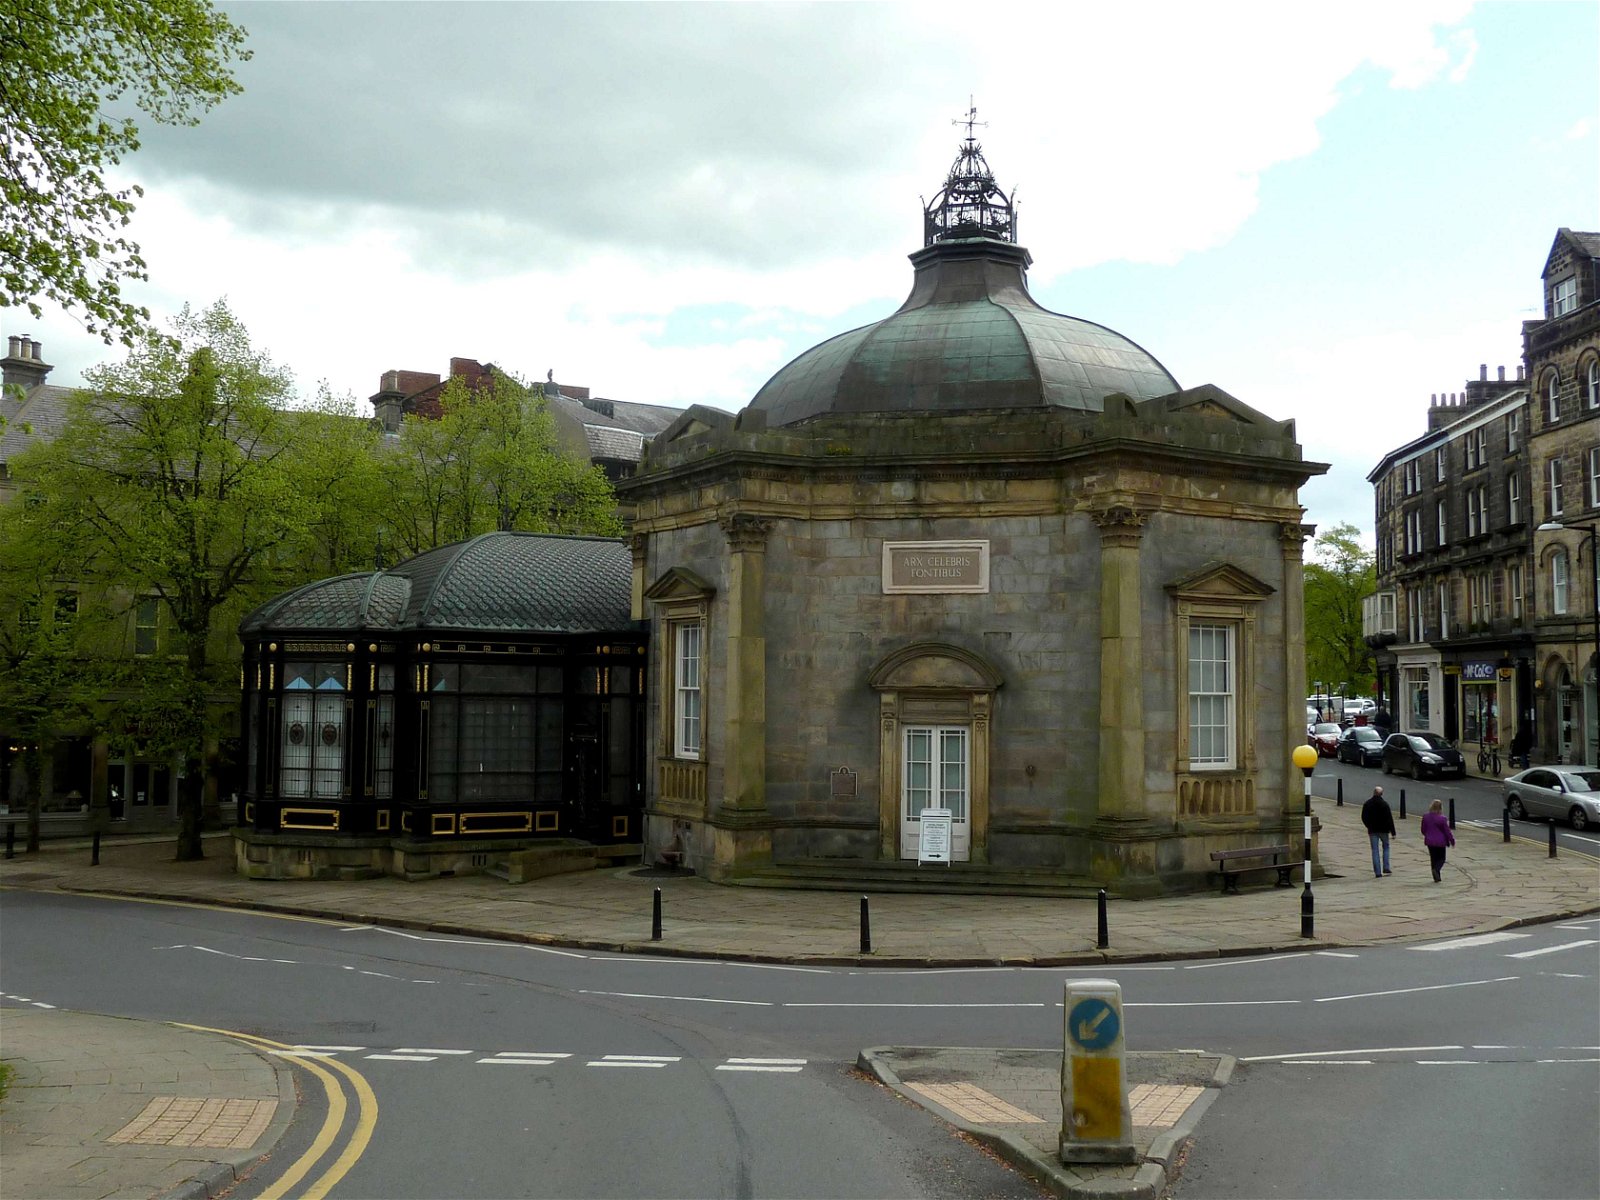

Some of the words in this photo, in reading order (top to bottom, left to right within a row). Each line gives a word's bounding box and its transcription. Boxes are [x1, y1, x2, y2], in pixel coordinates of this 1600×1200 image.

[903, 557, 923, 567] ARX
[927, 557, 970, 567] CELEBRIS
[911, 568, 962, 577] FONTIBUS
